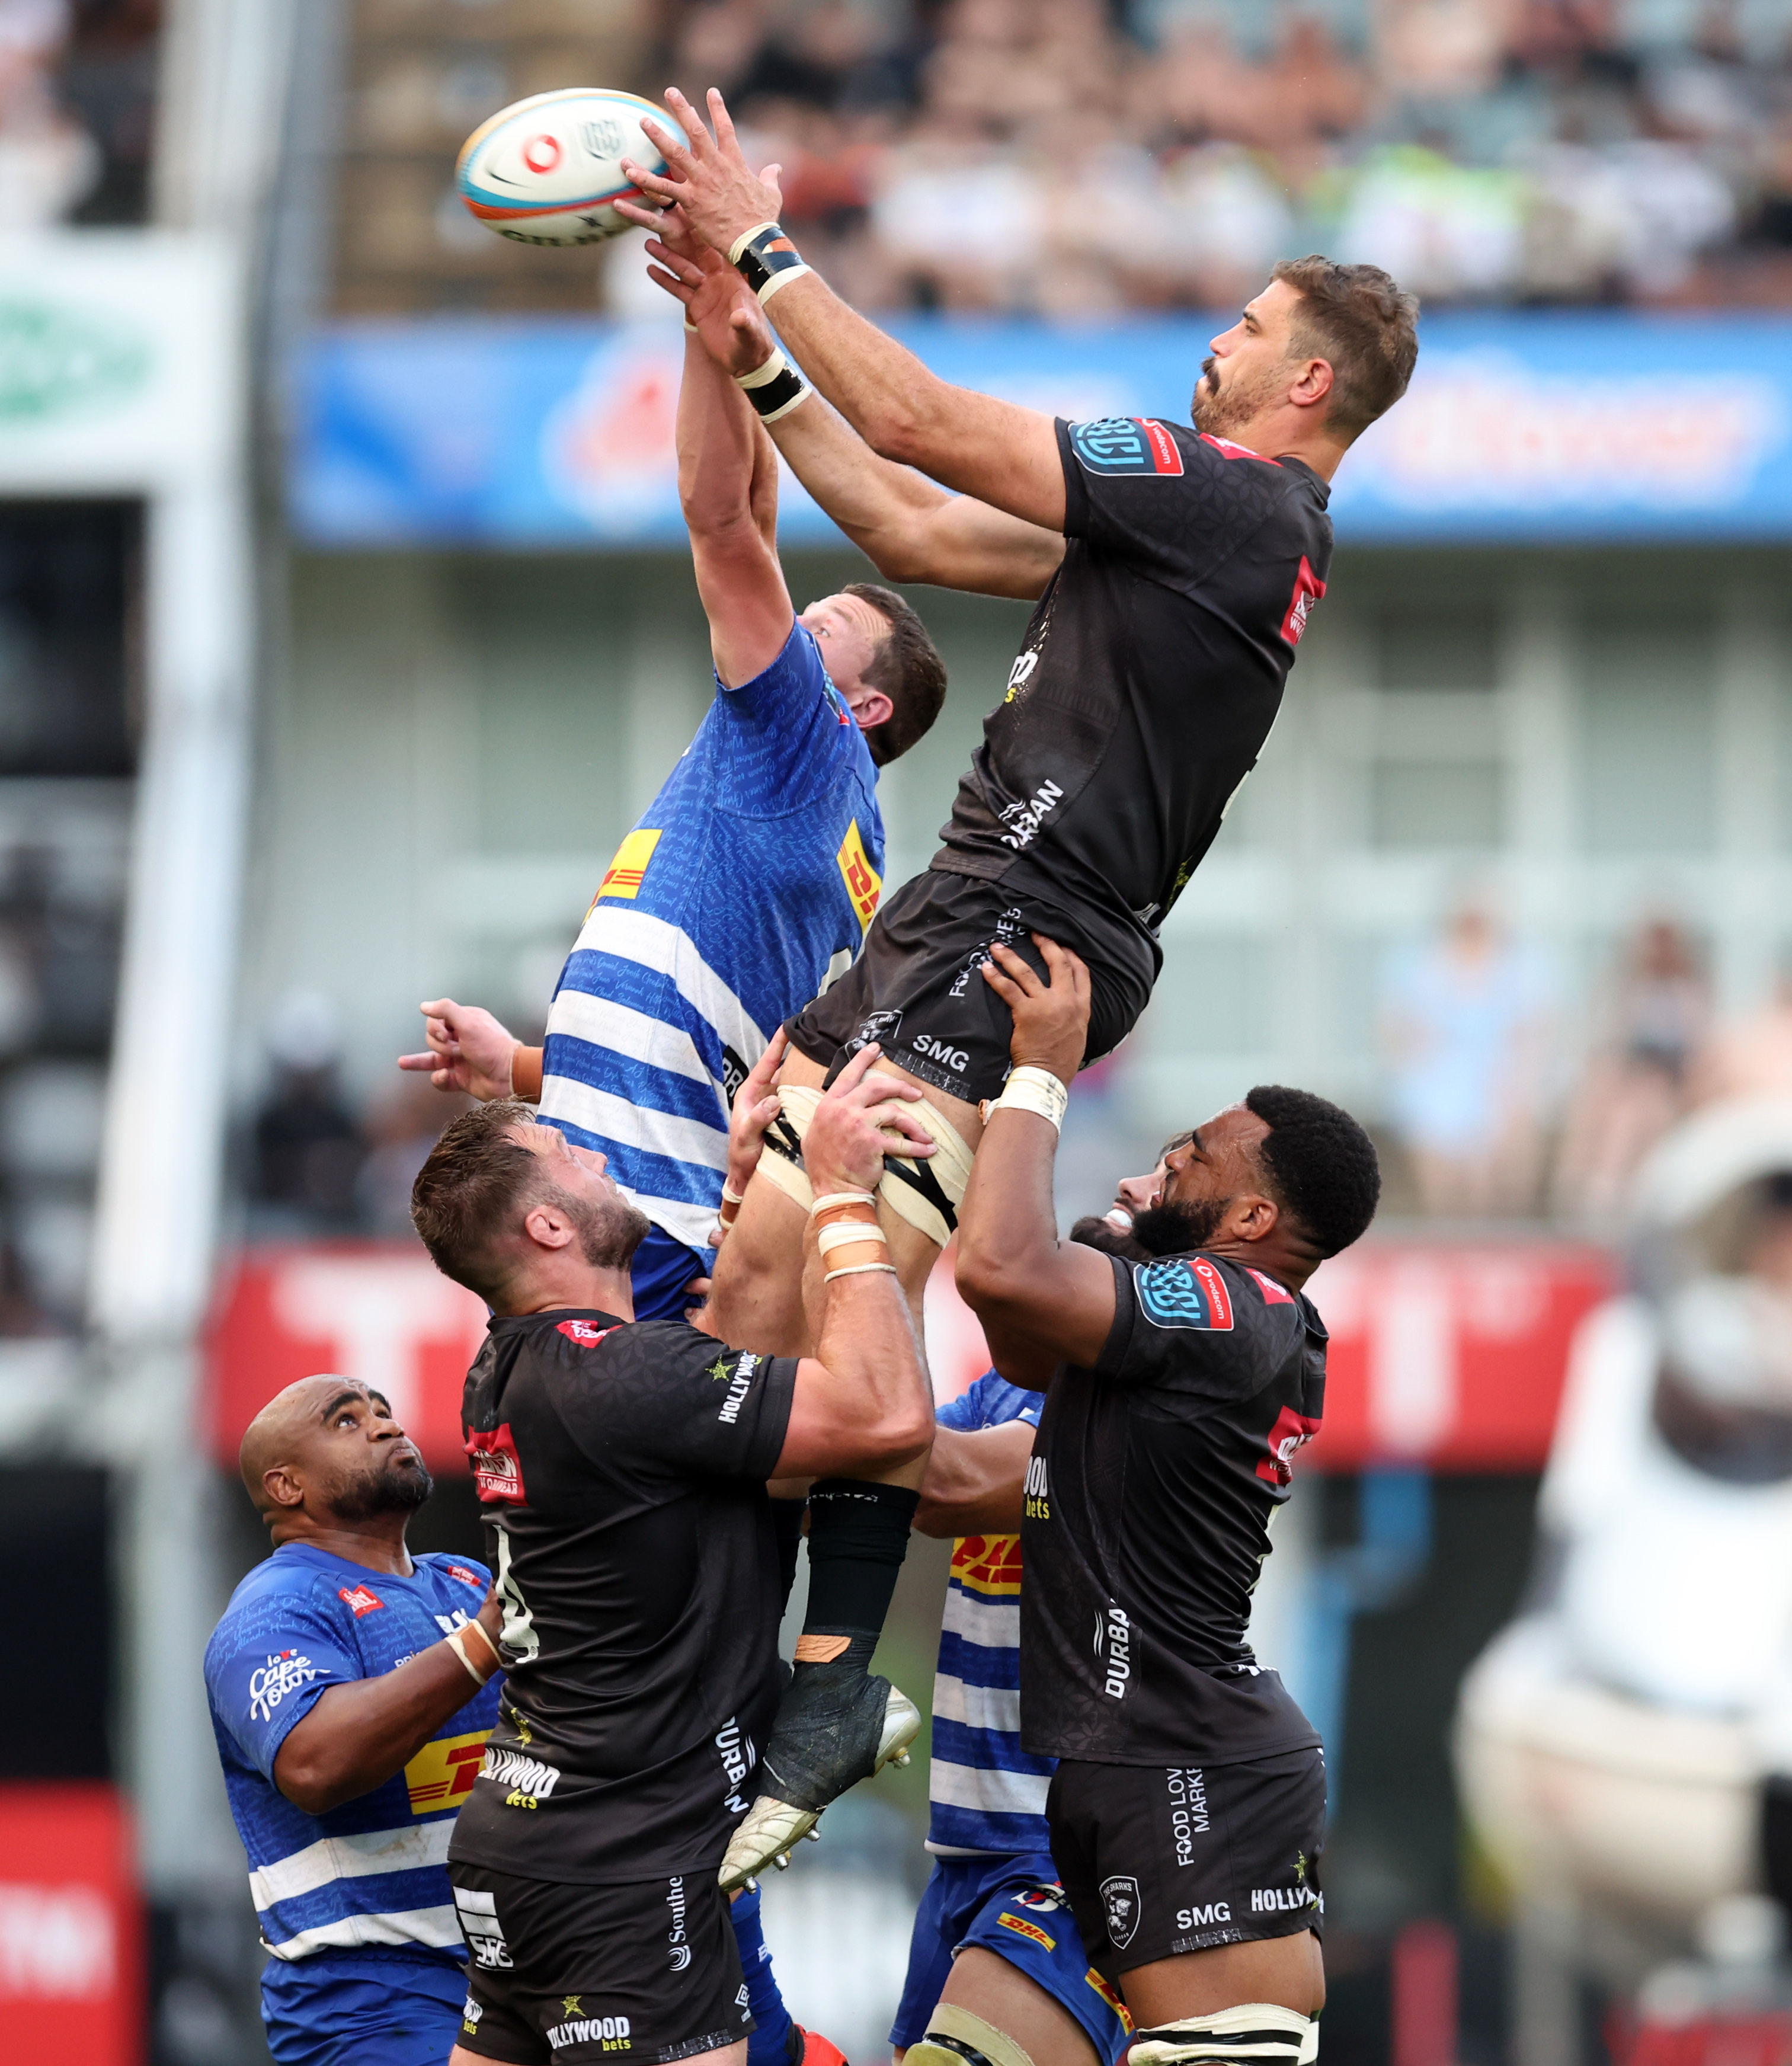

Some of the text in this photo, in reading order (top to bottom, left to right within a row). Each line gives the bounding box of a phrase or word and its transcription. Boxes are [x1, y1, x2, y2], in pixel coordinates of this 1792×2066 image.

[1152, 426, 1172, 465] vodacom
[846, 850, 880, 925] DH
[913, 1034, 970, 1073] SMG
[1207, 1278, 1225, 1320] vodacom
[1026, 1493, 1050, 1520] bets
[267, 1648, 298, 1668] love
[1105, 1597, 1131, 1700] DURBA
[249, 1656, 312, 1700] Cape
[249, 1668, 331, 1723] Town
[1172, 1810, 1195, 1867] FOOD
[1109, 1882, 1132, 1892] SHARKS
[1006, 1917, 1048, 1944] DHL
[1176, 1901, 1231, 1930] SMG
[545, 2016, 631, 2050] OLLYWOOD
[601, 2038, 632, 2052] bets
